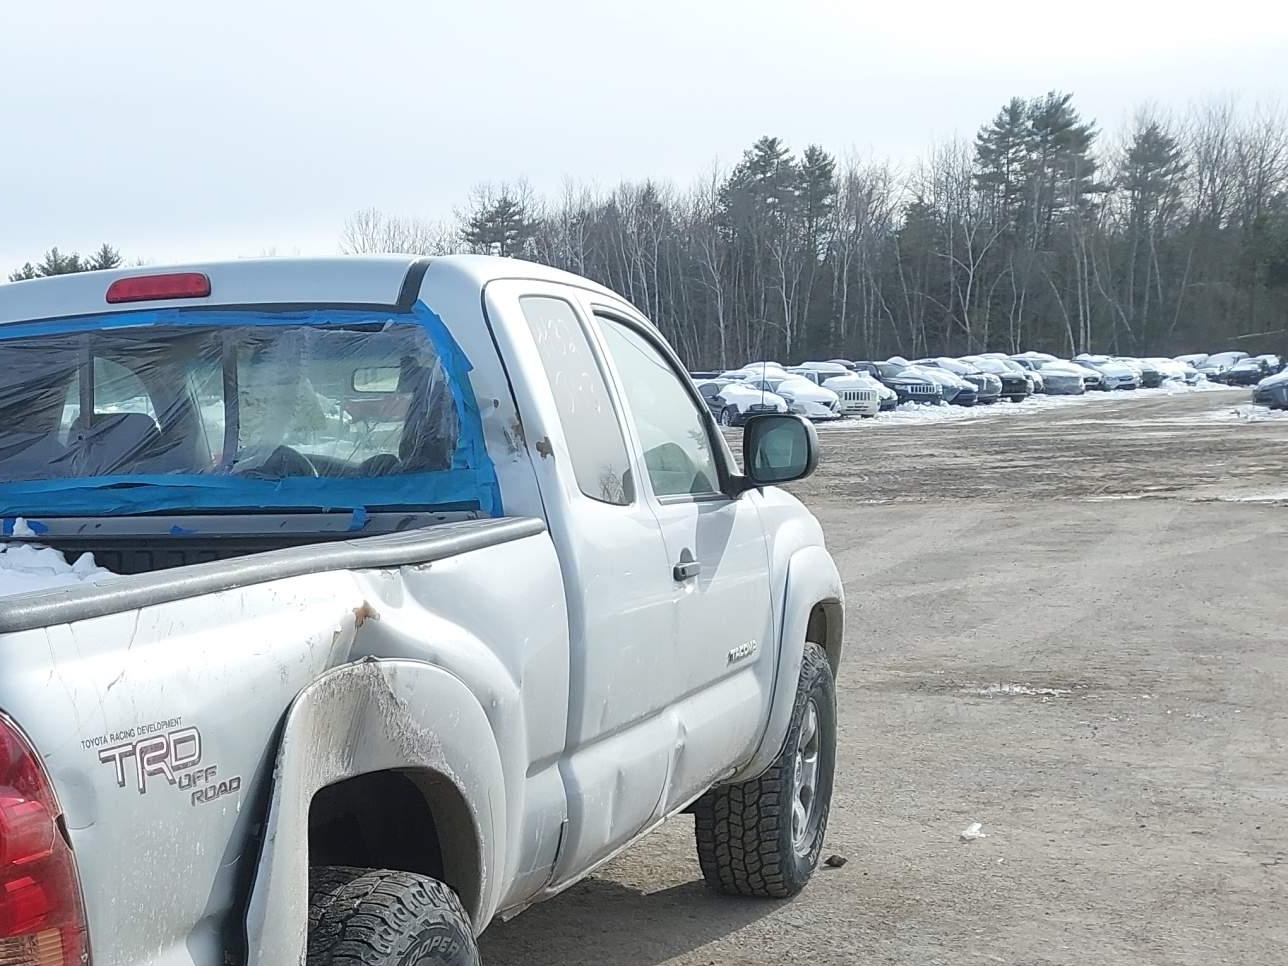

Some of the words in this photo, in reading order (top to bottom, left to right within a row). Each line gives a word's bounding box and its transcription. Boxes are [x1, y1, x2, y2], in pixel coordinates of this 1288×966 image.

[80, 735, 109, 750] TOYOTA
[109, 728, 136, 744] RACING
[136, 716, 183, 736] DEVELOPMENT
[97, 725, 202, 795] TRD
[177, 764, 218, 791] OFF
[190, 776, 241, 807] ROAD
